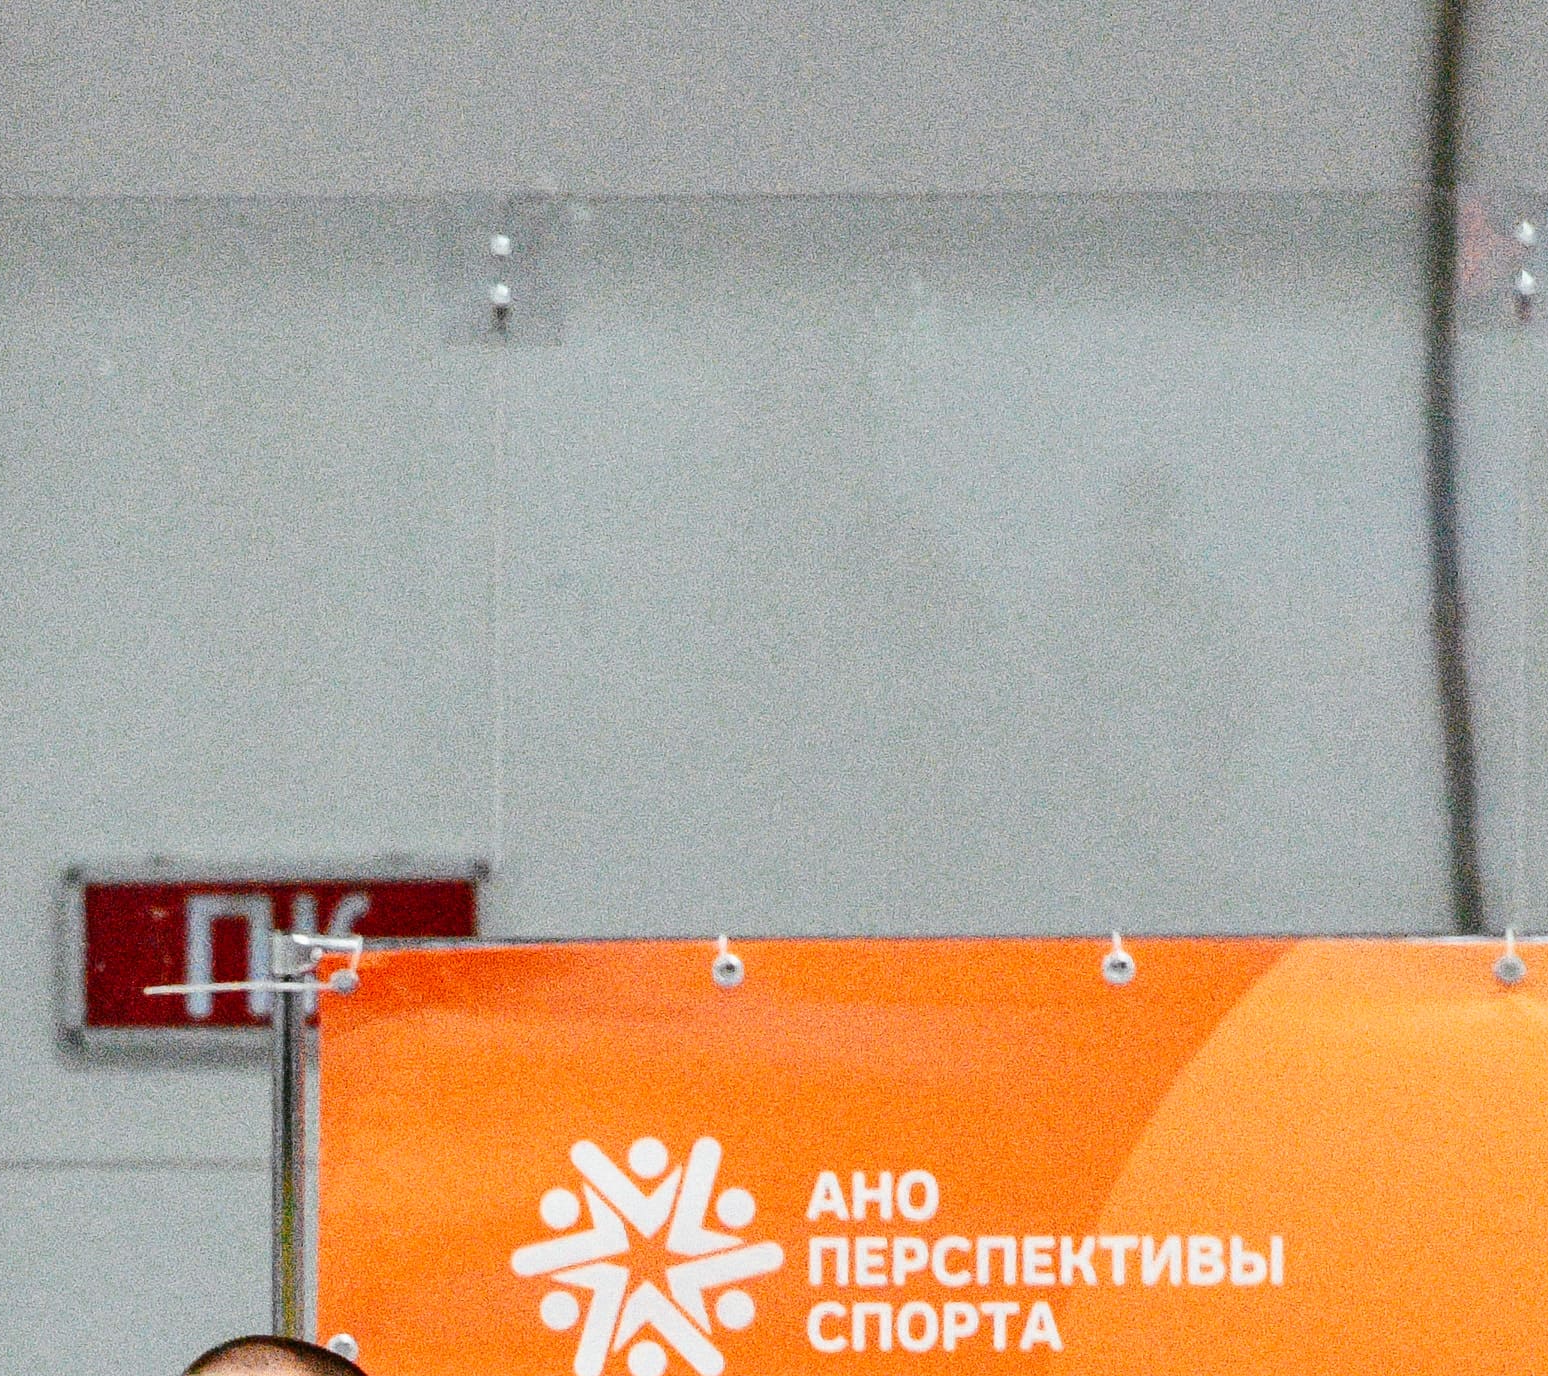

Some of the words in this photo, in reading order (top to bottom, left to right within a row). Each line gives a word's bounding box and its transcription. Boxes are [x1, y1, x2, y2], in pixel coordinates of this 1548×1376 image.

[806, 1169, 940, 1222] АНО
[807, 1234, 1286, 1288] ПЕРСПЕКТИВЫ
[806, 1300, 1065, 1354] СПОРТА
